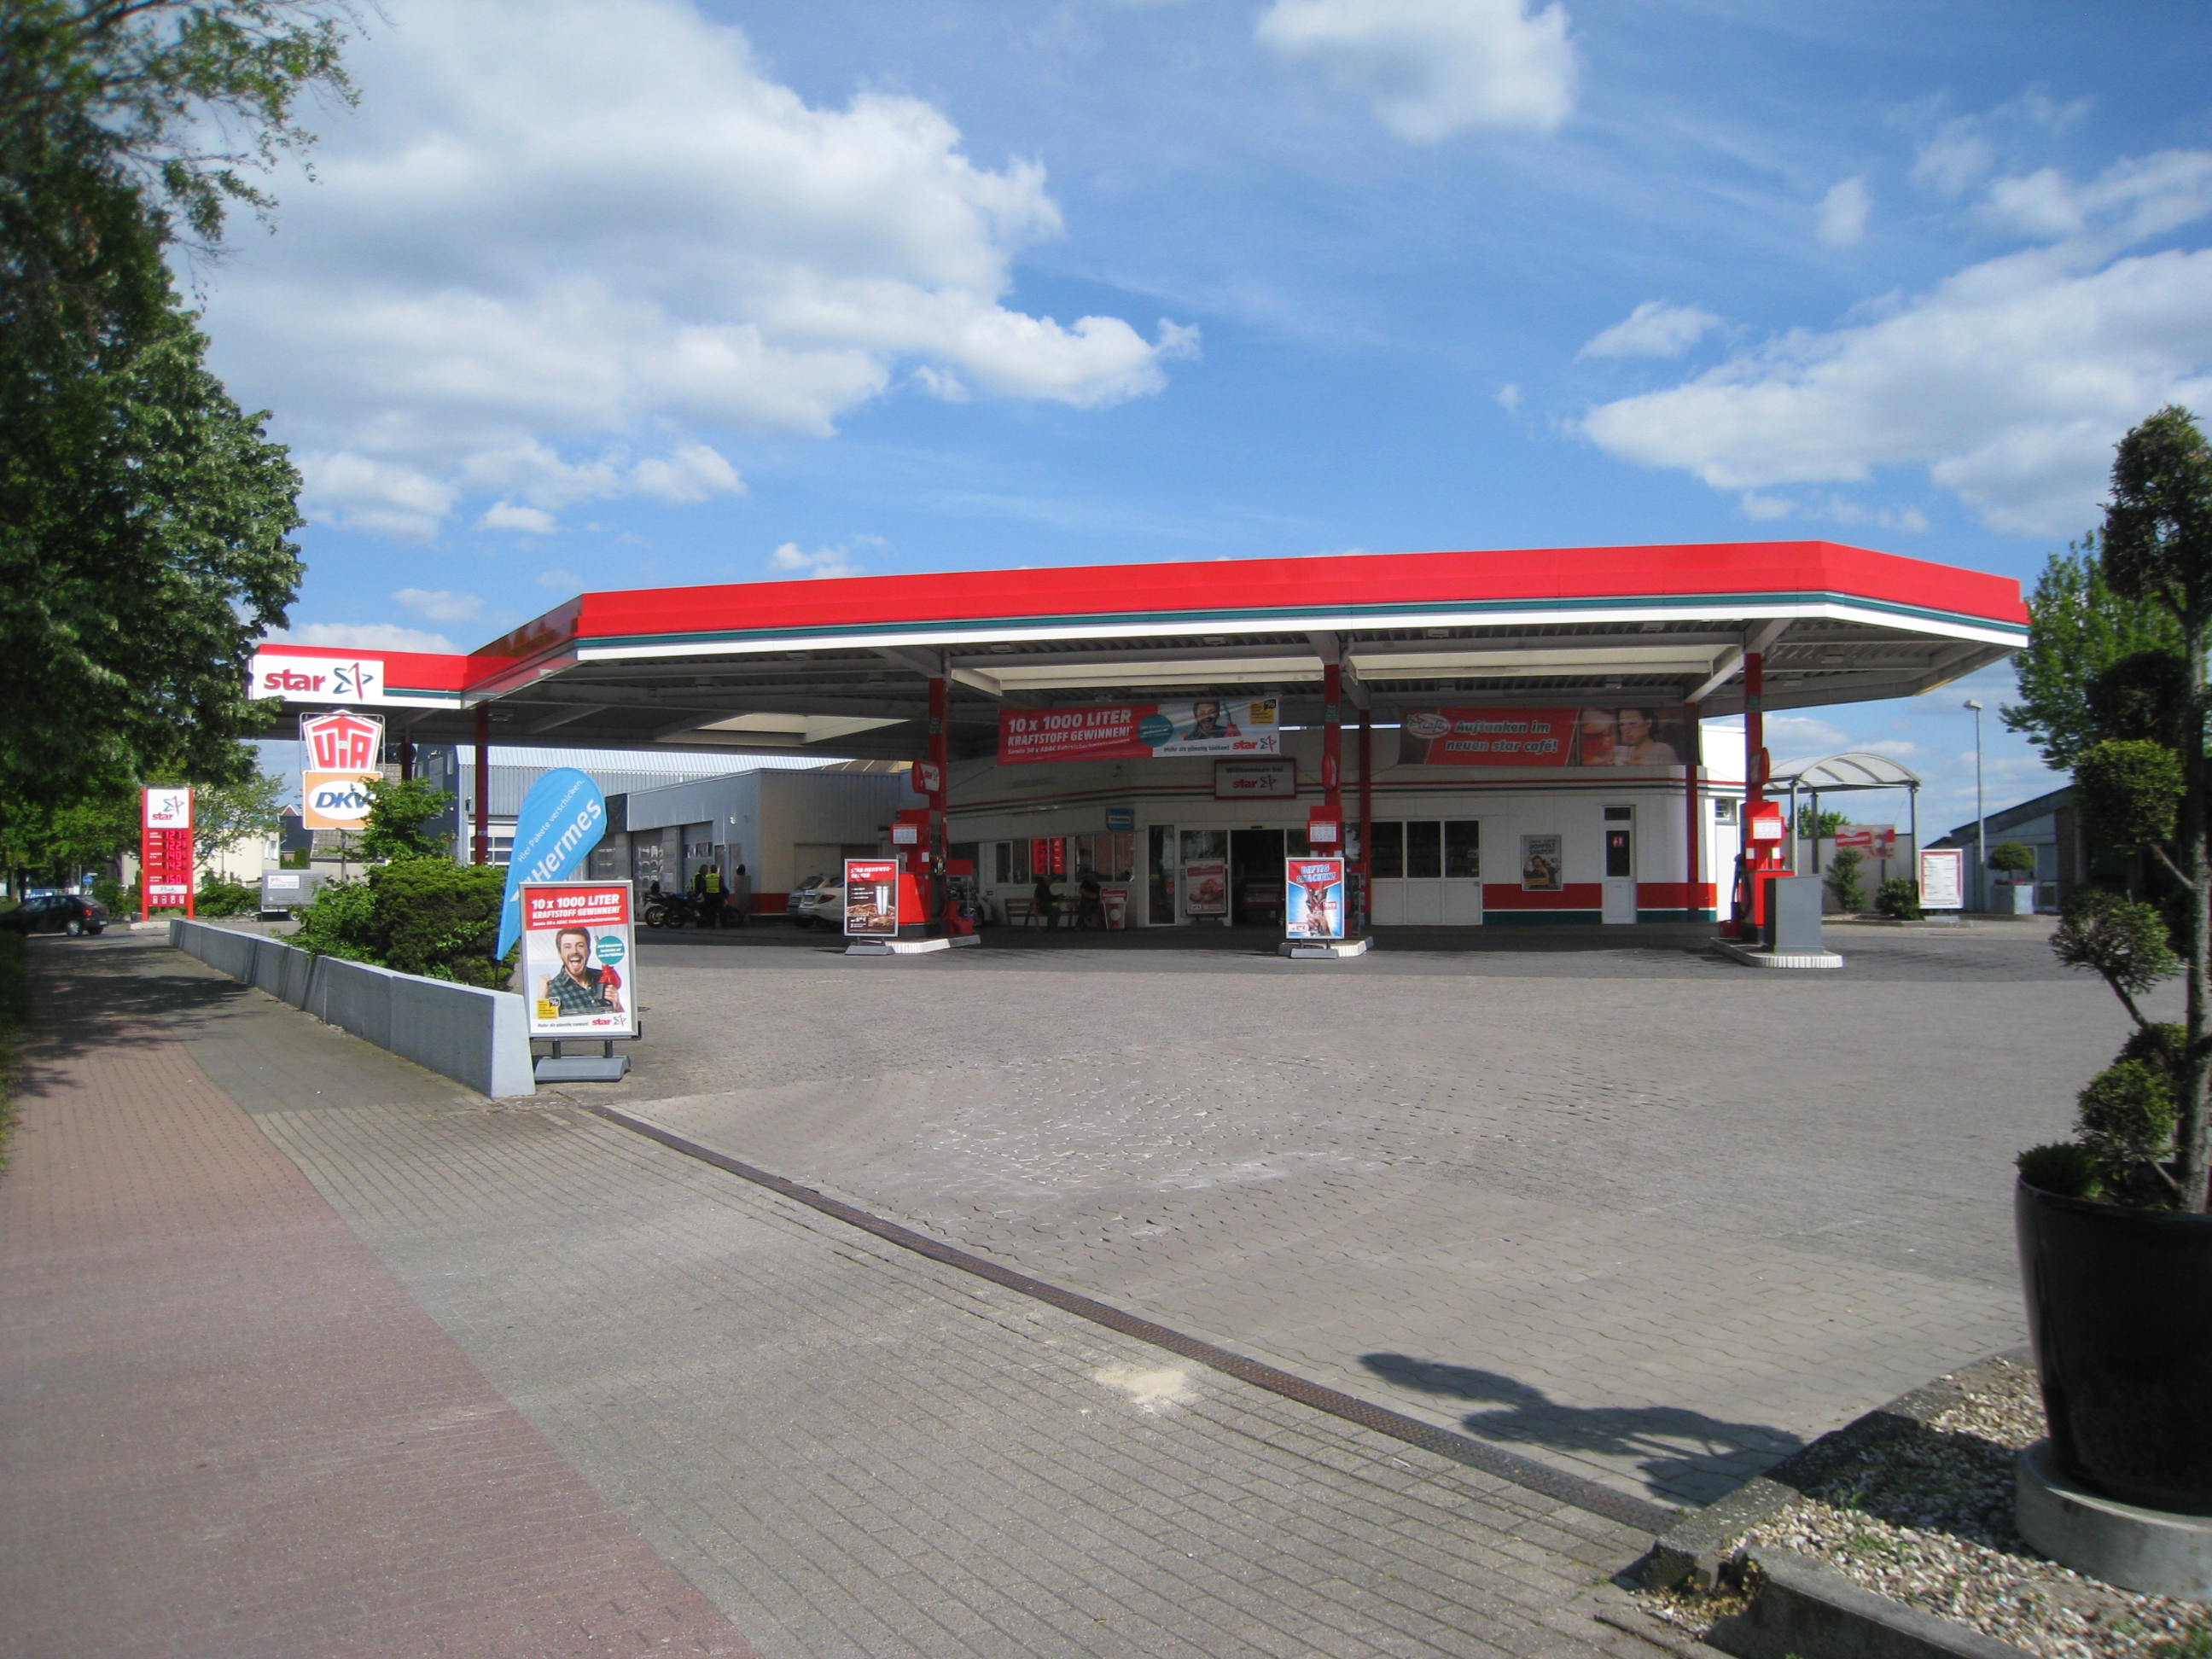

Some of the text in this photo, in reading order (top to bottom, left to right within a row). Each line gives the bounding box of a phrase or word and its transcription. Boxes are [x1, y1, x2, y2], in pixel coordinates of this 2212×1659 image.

[264, 668, 327, 692] star
[1008, 709, 1132, 733] 10 x 1000 LITER
[1454, 719, 1551, 735] Auftanken im
[311, 714, 375, 769] UTA
[1008, 731, 1068, 747] KRAFTSTOFF
[1232, 740, 1258, 751] star
[1446, 739, 1559, 755] neuen star café!
[1231, 777, 1258, 789] star
[315, 791, 373, 809] DKV
[152, 812, 174, 821] star
[517, 780, 585, 863] Hier Pakete verschicken.
[531, 798, 602, 882] Hermes
[532, 894, 620, 911] 10 x 1000 LITER
[532, 909, 577, 920] KRAFTSTOFF
[591, 1017, 613, 1026] star
